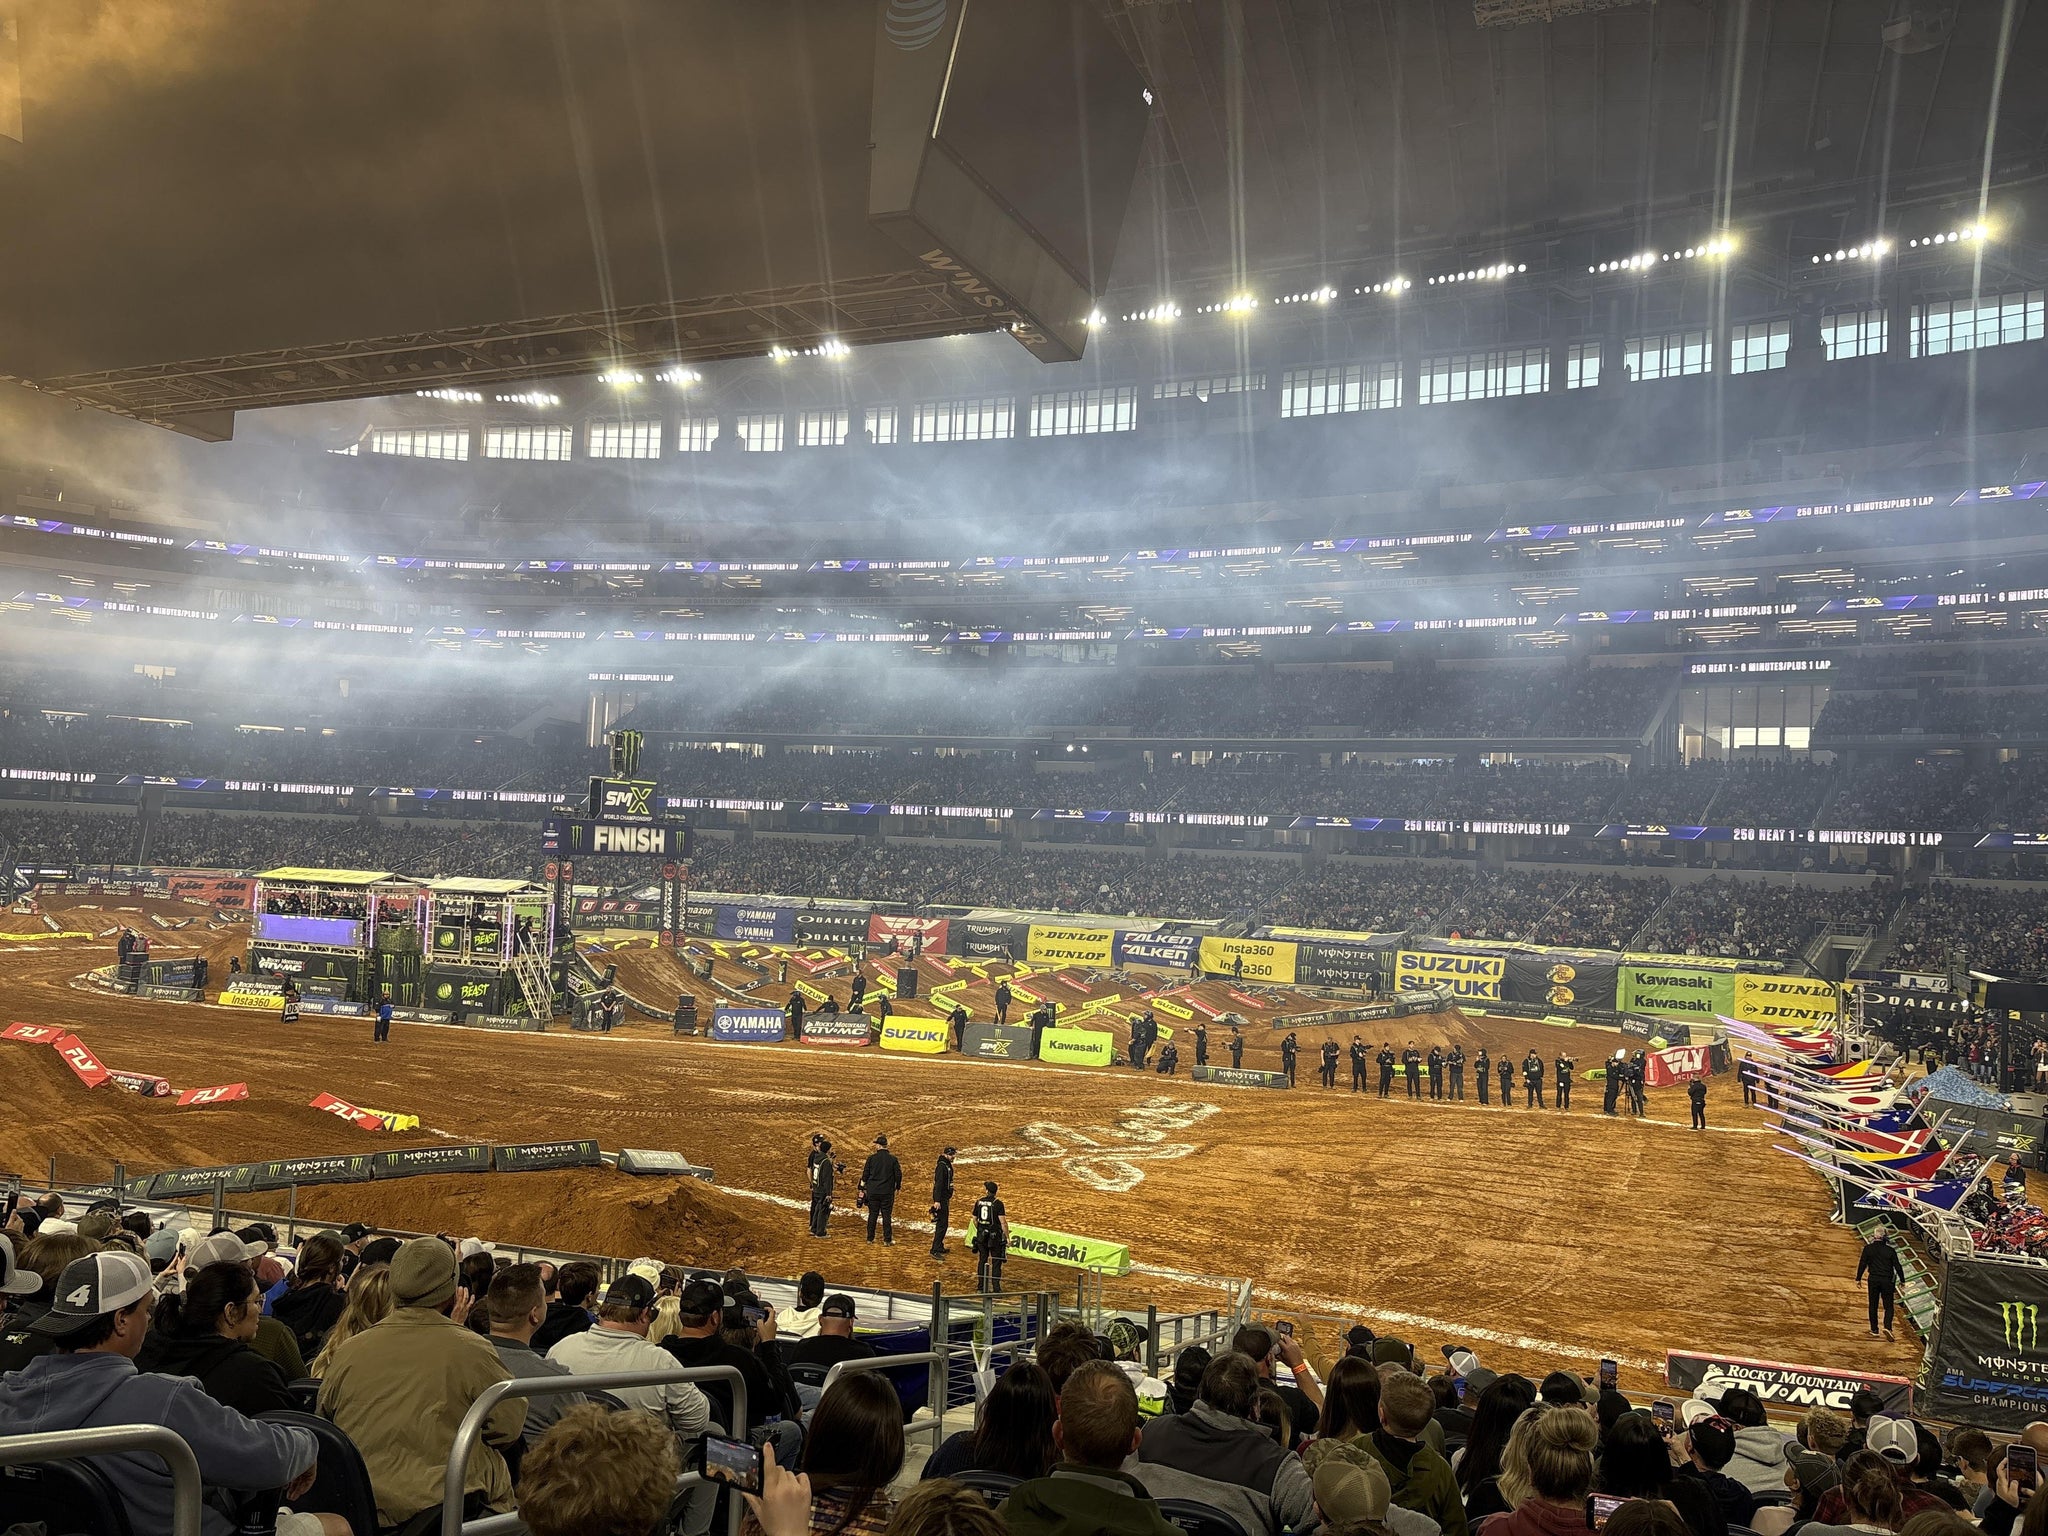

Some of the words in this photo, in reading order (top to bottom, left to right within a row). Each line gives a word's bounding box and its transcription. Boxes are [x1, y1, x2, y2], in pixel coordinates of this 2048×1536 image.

[594, 825, 665, 854] FINISH
[1920, 833, 1942, 845] LAP
[581, 901, 594, 911] QT
[603, 902, 615, 911] QT
[624, 903, 637, 911] QT
[687, 907, 713, 916] mazon
[586, 914, 625, 923] MONSTER
[746, 911, 776, 921] YAMAHA
[816, 917, 866, 926] OAKLEY
[744, 927, 774, 937] YAMAHA
[967, 924, 1003, 935] TRIUMPH
[1045, 931, 1108, 942] DUNLOP
[1123, 932, 1193, 946] FALKEN
[1043, 949, 1106, 960] DUNLOP
[1120, 944, 1188, 960] FALKEN
[1223, 942, 1274, 957] Insta360
[1317, 948, 1375, 961] MONSTER
[1400, 955, 1500, 977] SUZUKI
[1635, 971, 1713, 990] Kawasaki
[797, 984, 826, 1002] SUZUKI
[933, 982, 963, 994] SUZUKI
[1010, 987, 1034, 1001] UZUKI
[231, 995, 270, 1009] Insta360
[1156, 999, 1191, 1016] SUZUKI
[1634, 994, 1712, 1013] Kawasaki
[1192, 1002, 1217, 1018] HONDA
[1357, 1008, 1388, 1018] MONSTER
[486, 1017, 518, 1025] MONSTER
[732, 1015, 782, 1029] YAMAHA
[1291, 1014, 1325, 1023] MONSTER
[13, 1026, 50, 1037] FLY
[884, 1027, 945, 1042] SUZUKI
[1049, 1039, 1103, 1053] Kawasaki
[65, 1047, 98, 1071] FLY
[1218, 1070, 1261, 1081] MONSTER
[190, 1087, 230, 1104] FLY
[323, 1101, 367, 1122] FLY
[403, 1149, 464, 1161] MONSTER
[521, 1143, 576, 1155] MONSTER
[285, 1159, 346, 1173] MONSTER
[180, 1170, 232, 1182] MONSTER
[981, 1206, 988, 1220] 6
[1010, 1234, 1088, 1264] awasaki
[66, 1284, 91, 1307] 4
[1726, 1364, 1778, 1383] ROCKY
[1778, 1370, 1862, 1392] MOUNTAIN
[1946, 1367, 1964, 1378] AMA
[1973, 1394, 2048, 1414] CHAMPIONS
